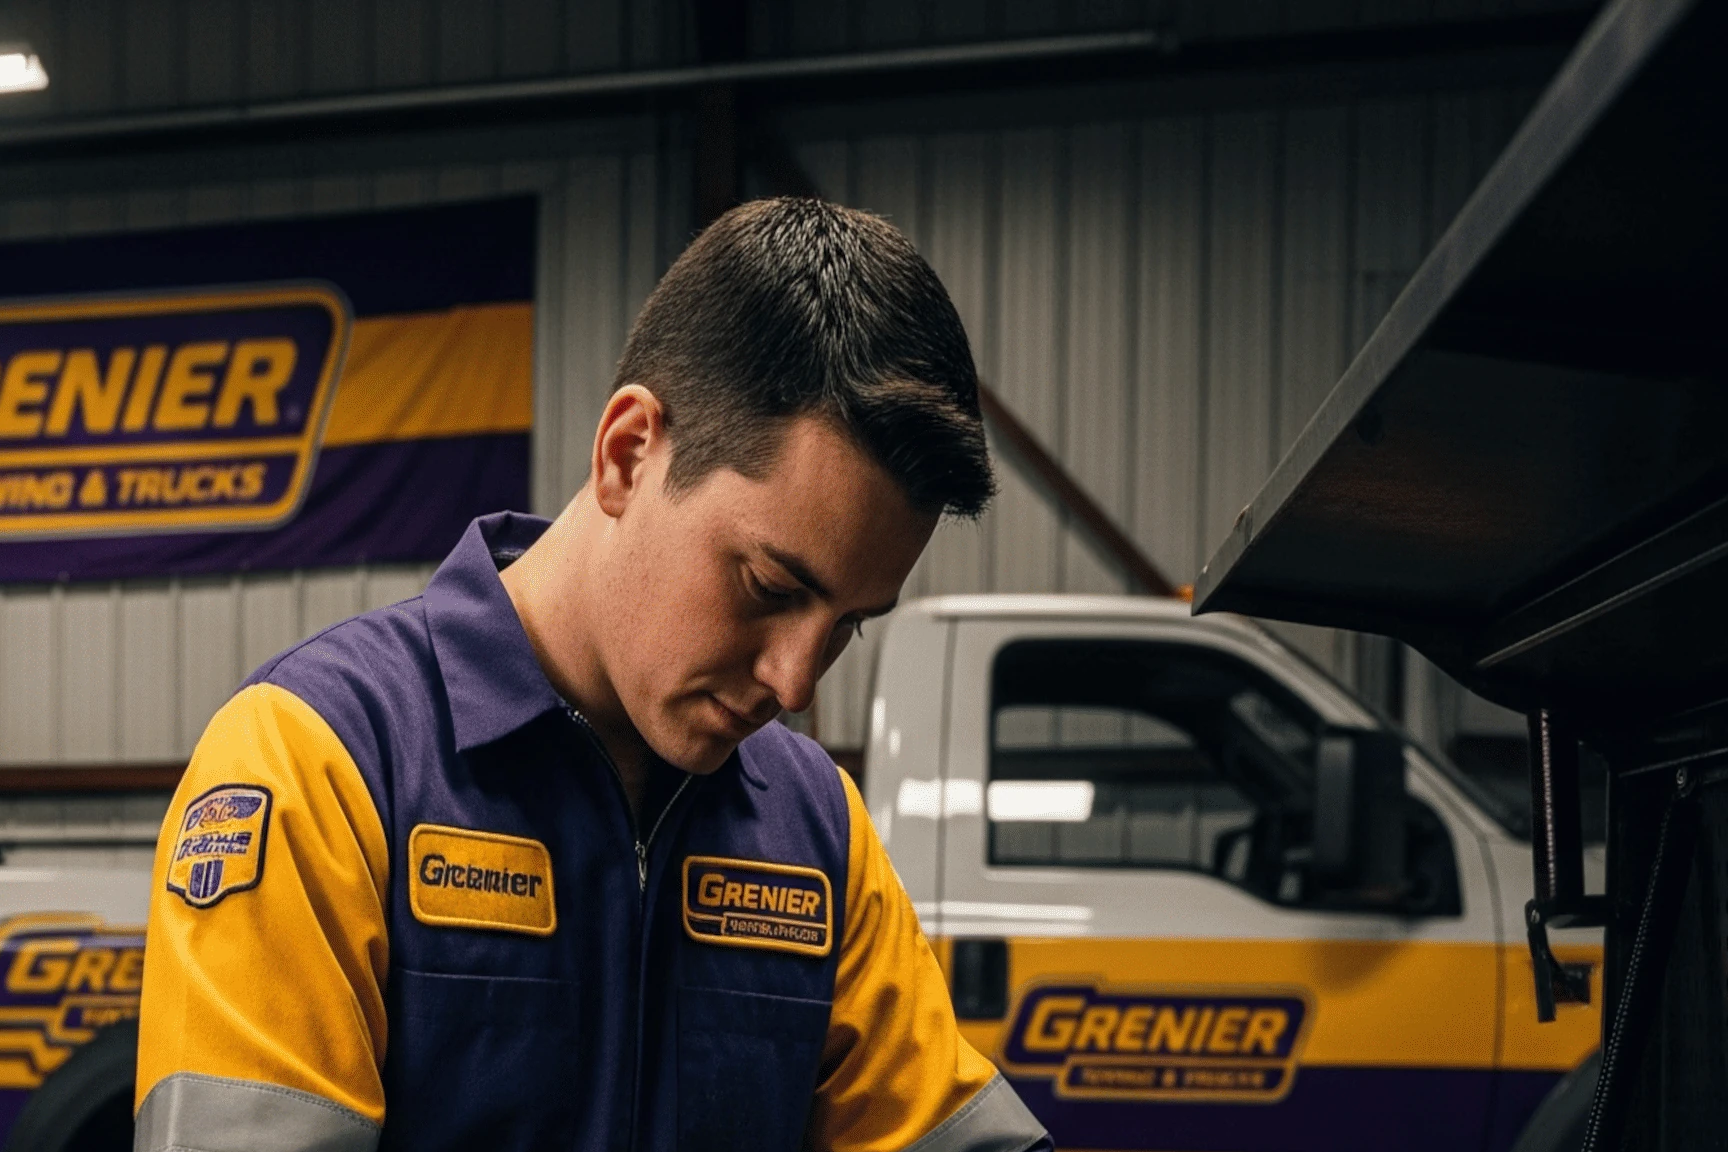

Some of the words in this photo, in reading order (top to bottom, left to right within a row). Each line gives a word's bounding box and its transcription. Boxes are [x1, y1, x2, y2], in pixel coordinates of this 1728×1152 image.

[118, 462, 267, 505] TRUCKS
[697, 873, 821, 917] GRENIER
[1024, 996, 1289, 1053] GRENIER
